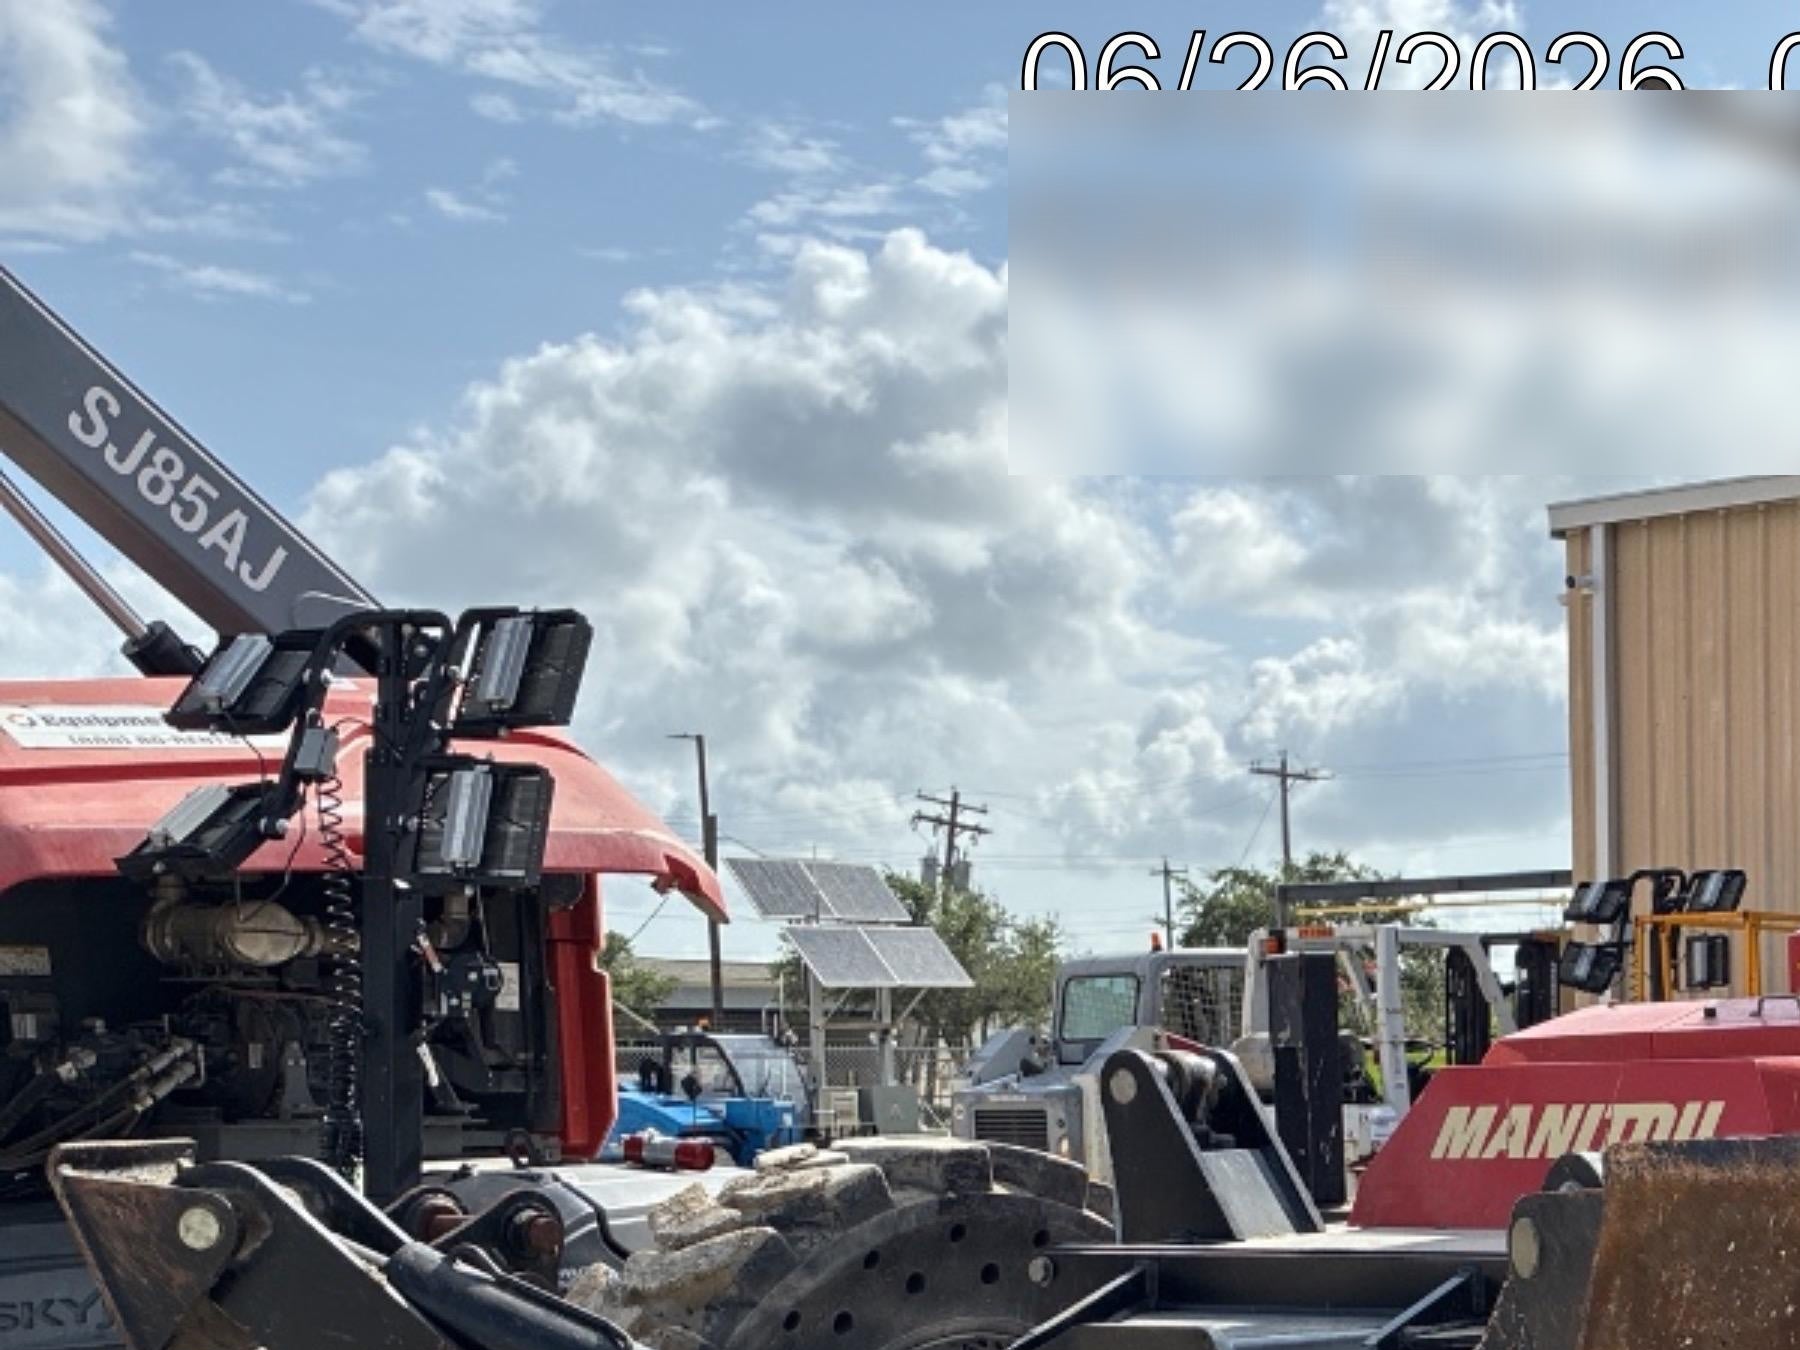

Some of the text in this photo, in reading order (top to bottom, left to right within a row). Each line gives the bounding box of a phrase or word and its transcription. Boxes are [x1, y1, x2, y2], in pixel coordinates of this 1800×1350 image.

[68, 386, 288, 592] SJ85AJ
[1429, 1101, 1727, 1160] MANITOU
[0, 1287, 110, 1331] SKY
